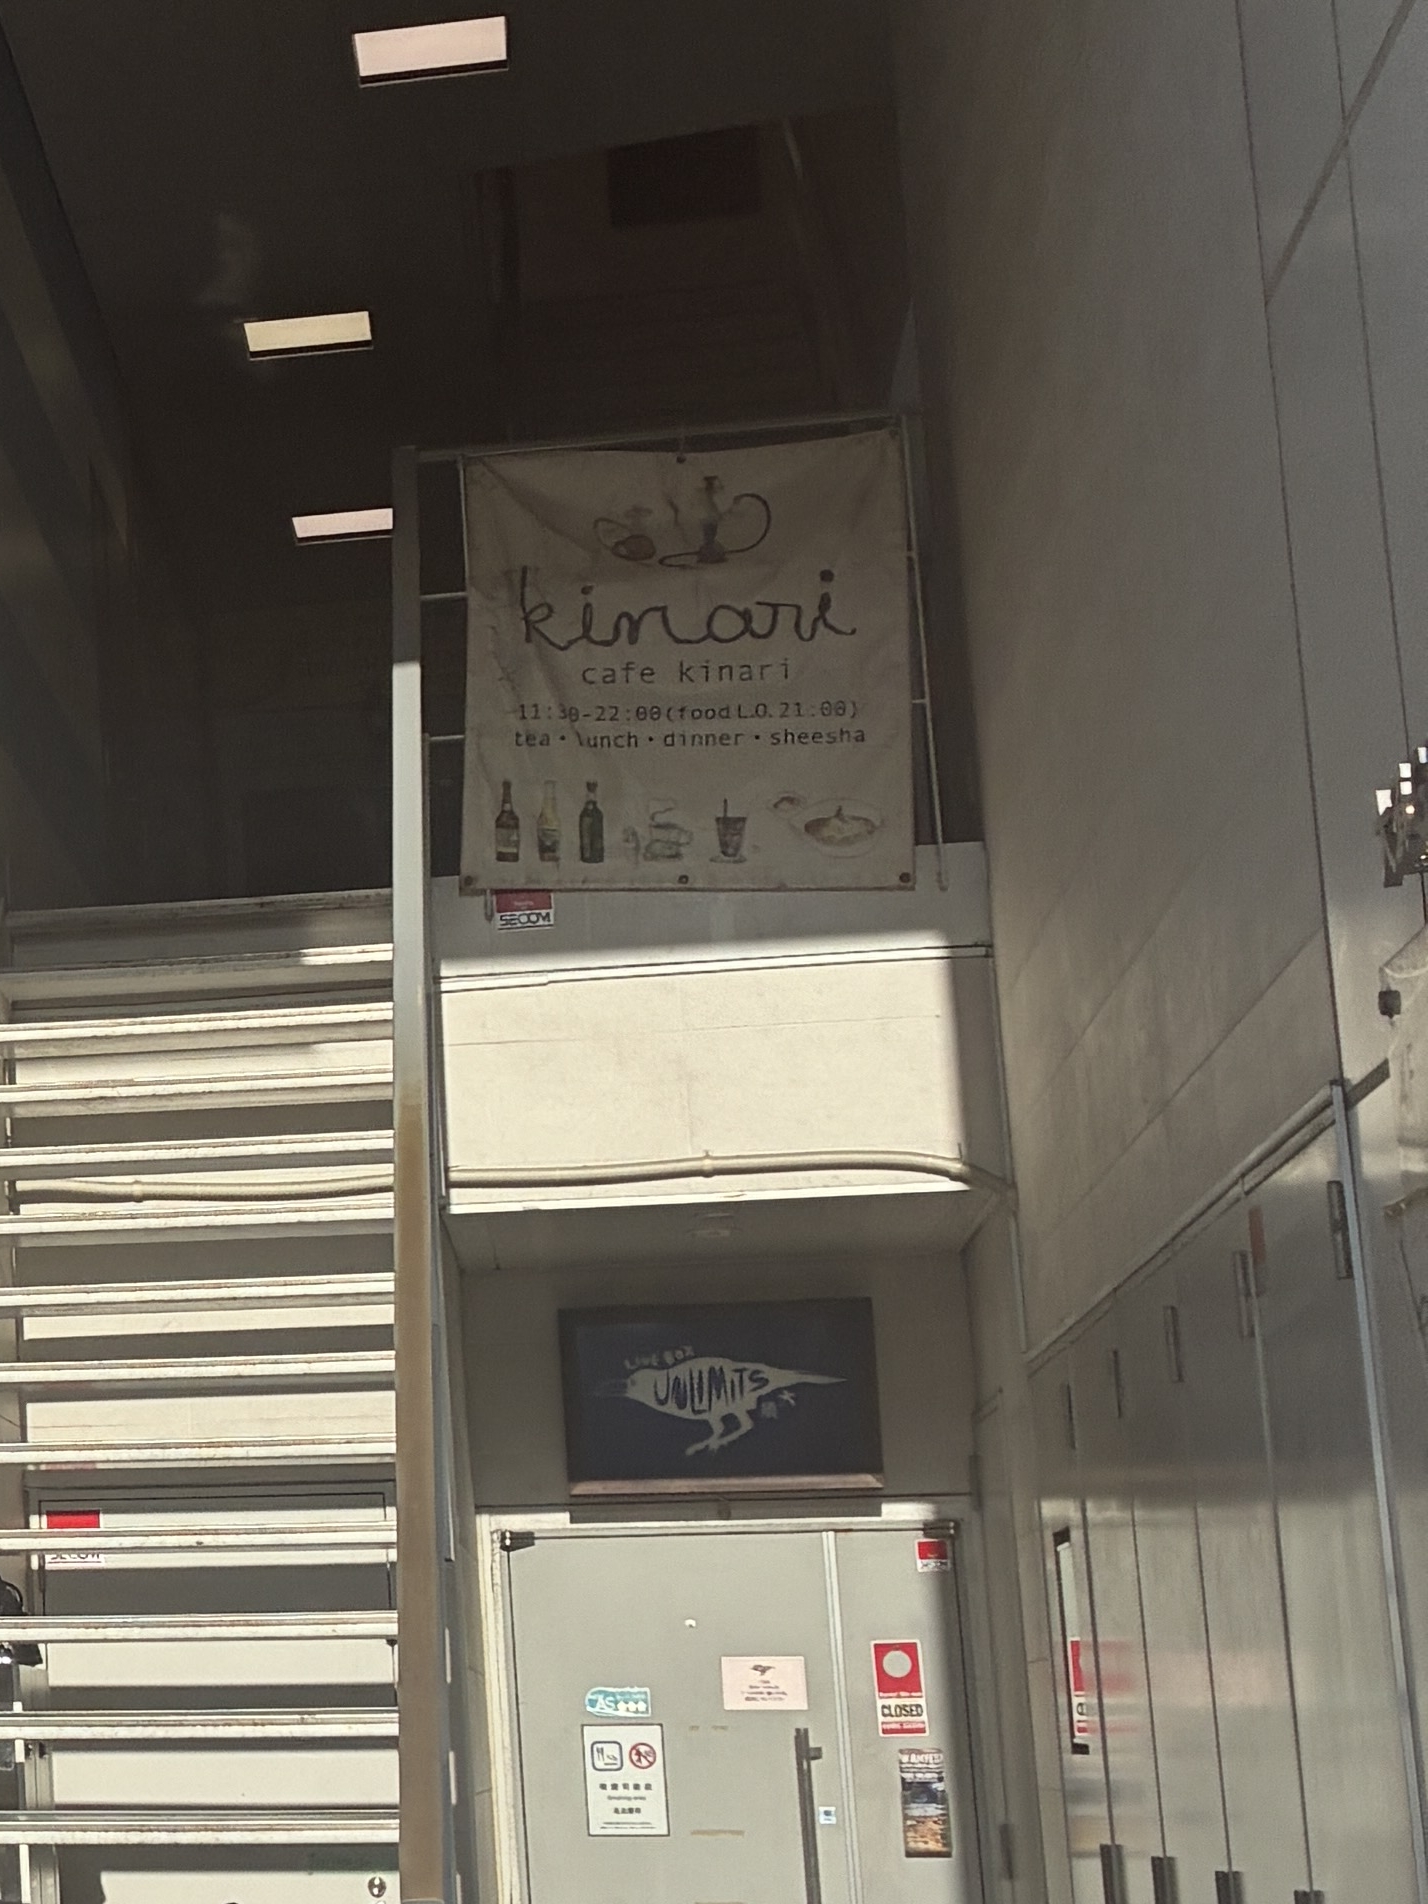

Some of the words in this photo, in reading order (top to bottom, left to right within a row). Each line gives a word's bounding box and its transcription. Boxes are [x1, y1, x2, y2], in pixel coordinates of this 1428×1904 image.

[518, 565, 857, 652] kinari
[581, 660, 656, 687] cafe
[677, 657, 791, 684] kinari
[513, 732, 552, 748] tea
[663, 729, 744, 748] dinner
[769, 726, 866, 747] sheesha
[499, 911, 552, 927] SECOM
[881, 1703, 924, 1718] CLOSED
